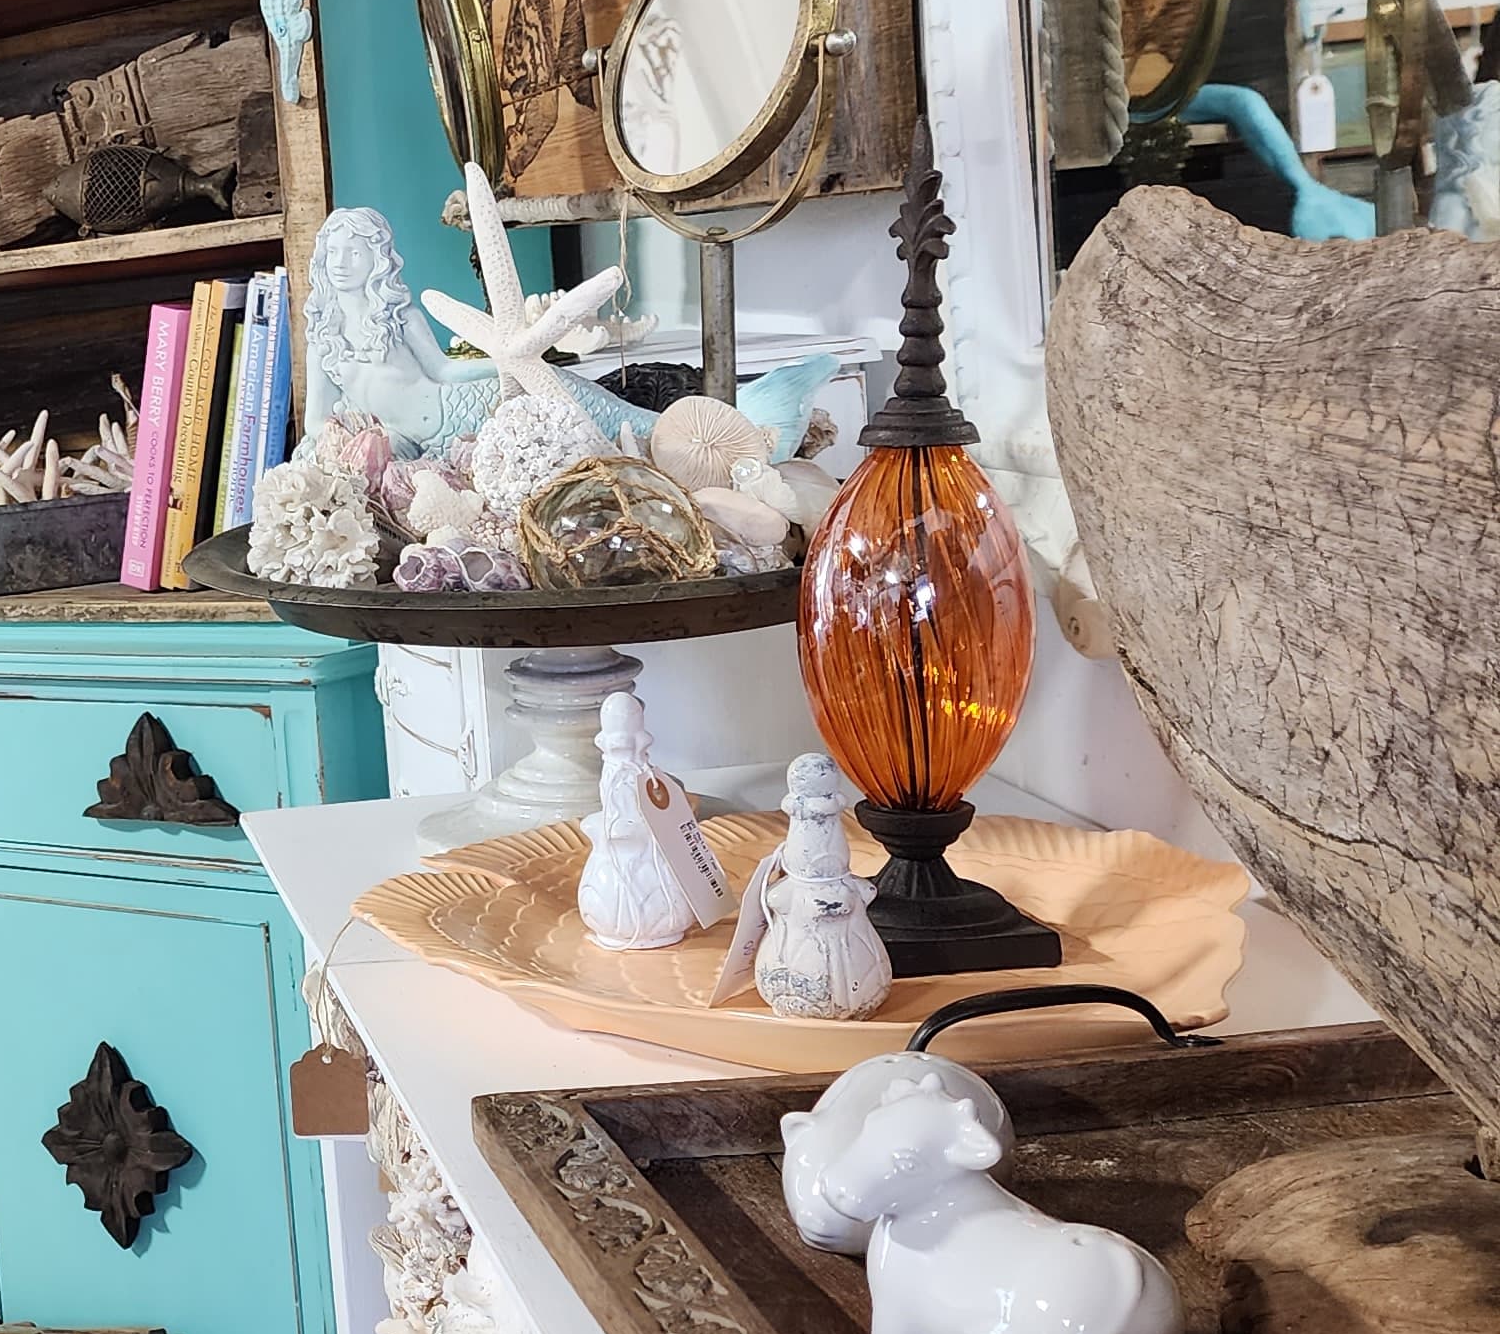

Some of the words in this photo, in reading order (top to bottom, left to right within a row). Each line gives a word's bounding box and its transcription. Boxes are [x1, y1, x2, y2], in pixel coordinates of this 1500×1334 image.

[152, 320, 171, 372] MARY
[244, 329, 265, 412] American
[148, 376, 165, 428] BERRY
[182, 358, 198, 407] Country
[194, 347, 213, 429] COTTAGE
[147, 430, 159, 467] COOKS
[172, 415, 192, 485] Decorating
[186, 432, 202, 484] HOME
[236, 414, 256, 515] Farmhouses
[147, 471, 156, 486] TO
[139, 488, 155, 549] PERFECTION
